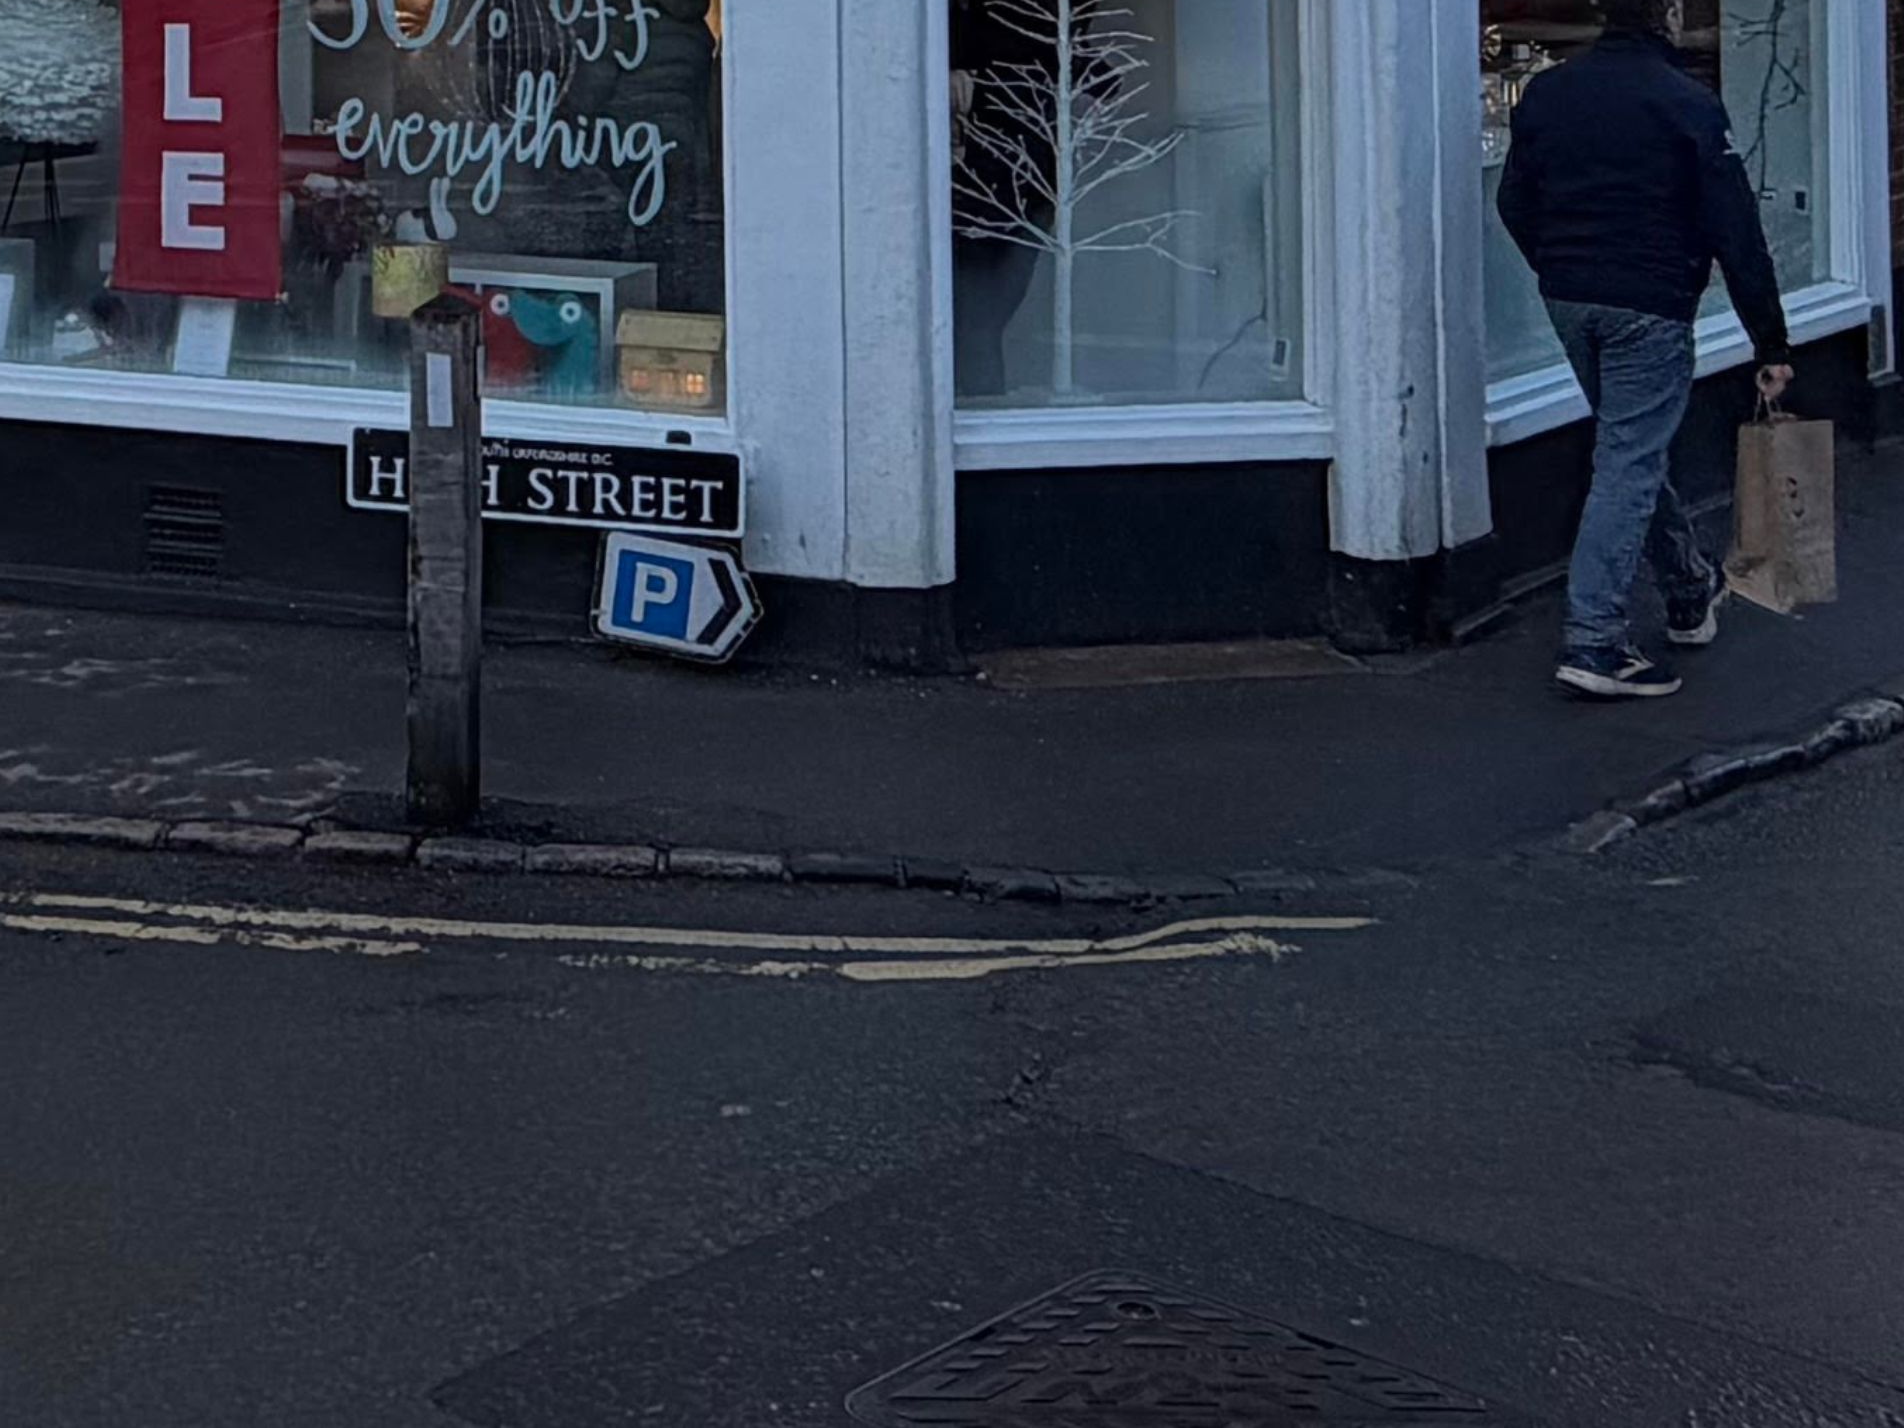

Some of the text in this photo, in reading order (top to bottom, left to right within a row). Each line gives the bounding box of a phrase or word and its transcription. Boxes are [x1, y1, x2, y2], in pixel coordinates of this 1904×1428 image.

[328, 70, 678, 227] everything
[368, 456, 724, 523] HH STREET
[631, 561, 679, 624] P
